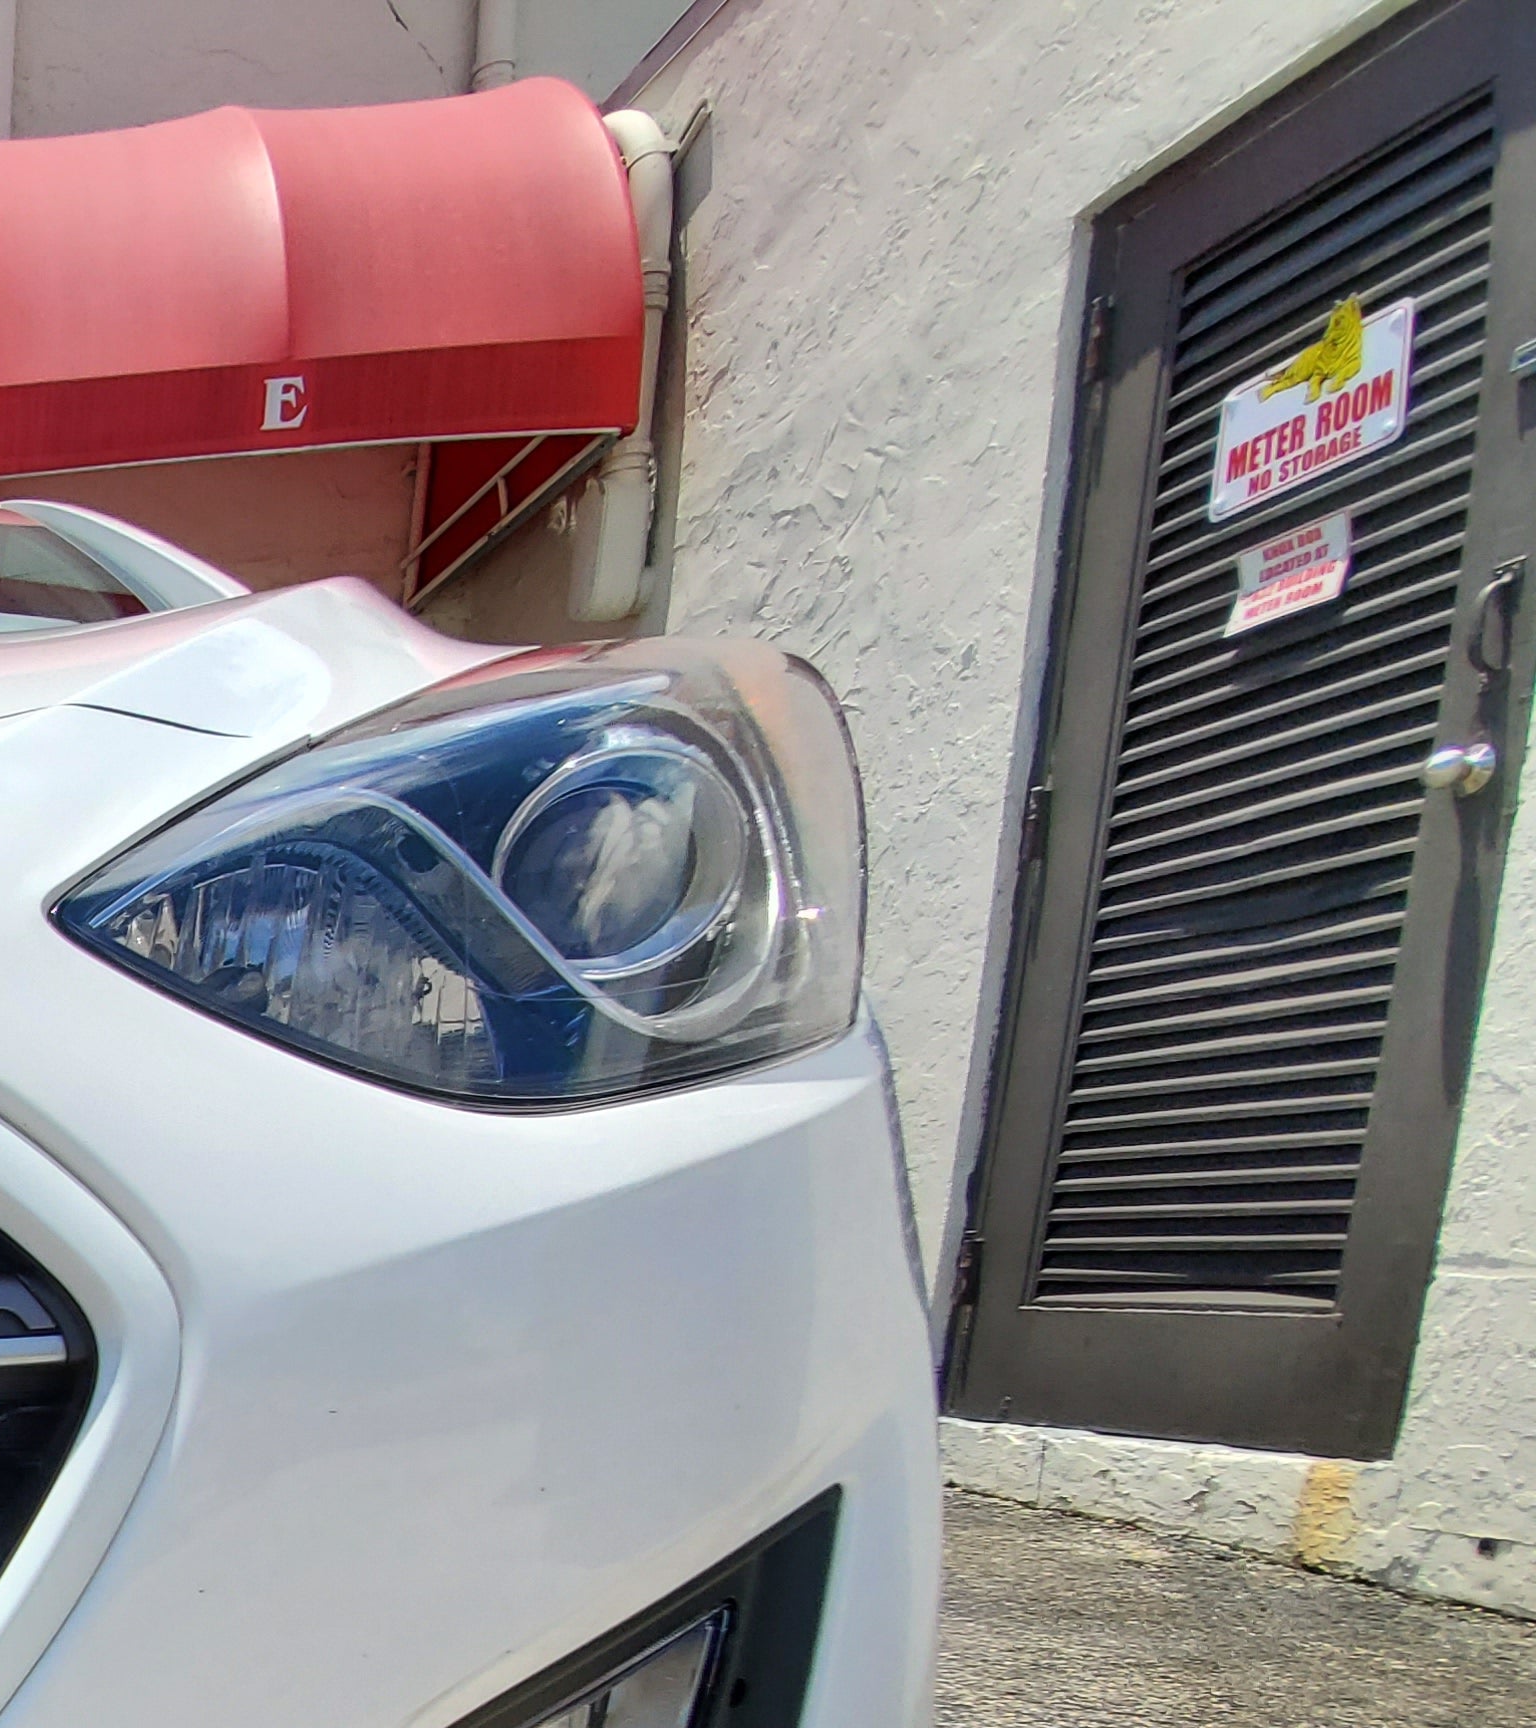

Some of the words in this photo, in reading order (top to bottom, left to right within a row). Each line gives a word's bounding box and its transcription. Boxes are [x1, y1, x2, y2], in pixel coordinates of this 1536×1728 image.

[259, 376, 308, 431] E
[1226, 415, 1306, 483] METER
[1315, 369, 1394, 441] ROOM
[1248, 469, 1272, 497] NO
[1279, 426, 1362, 482] STORAGE
